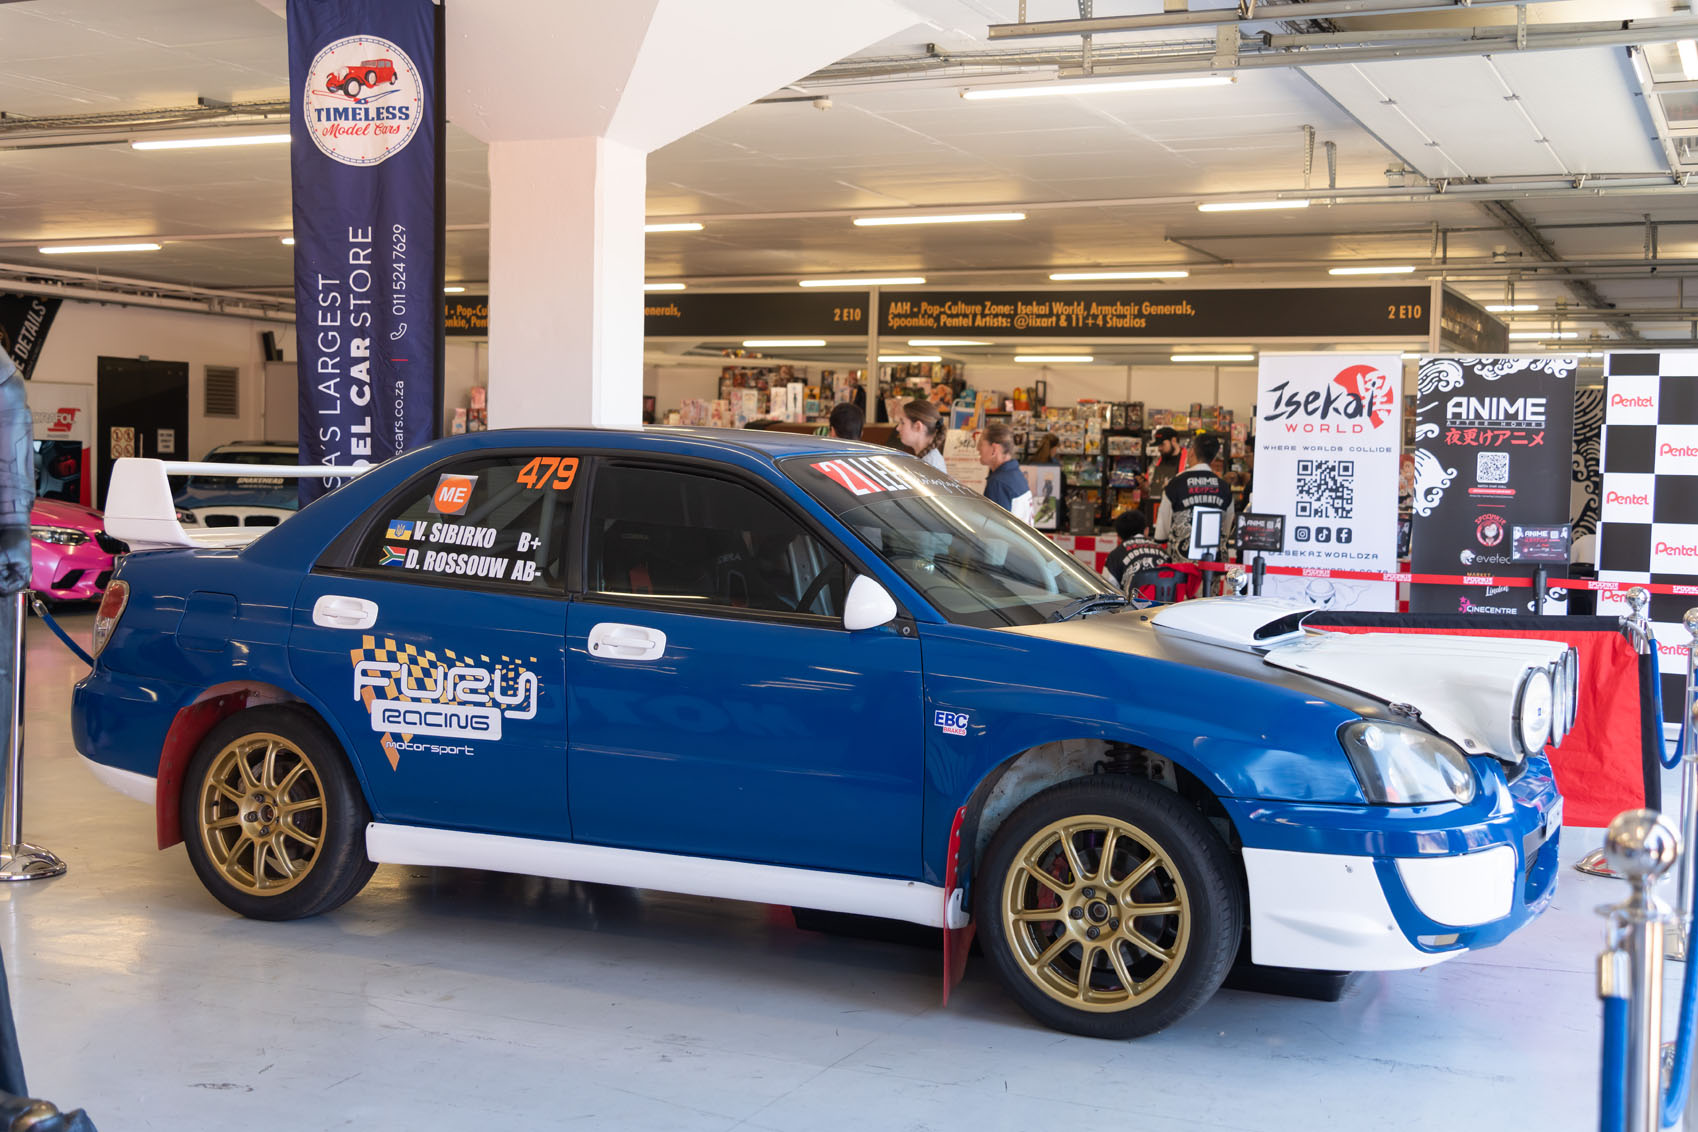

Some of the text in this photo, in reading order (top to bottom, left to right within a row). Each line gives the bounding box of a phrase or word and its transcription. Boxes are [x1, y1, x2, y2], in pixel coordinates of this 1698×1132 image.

[314, 106, 410, 122] TIMELESS
[322, 122, 401, 138] Model Cars
[392, 224, 406, 260] 7629
[349, 226, 372, 326] STORE
[392, 262, 406, 290] 524
[392, 294, 406, 316] 011
[456, 304, 488, 318] Pop-Cu
[889, 302, 911, 314] AAH
[921, 301, 982, 317] Pop-Culture
[984, 302, 1014, 314] Zone:
[1018, 301, 1050, 315] Isekai
[1052, 301, 1087, 317] World,
[1090, 301, 1140, 315] Armchair
[1142, 300, 1196, 316] Generals,
[1388, 305, 1422, 319] 2 E10
[834, 308, 862, 321] 2 E10
[888, 314, 1146, 330] Spoonkie, Pentel Artists: @iixart & 11+4 Studios
[14, 300, 46, 360] DETAILS
[318, 274, 341, 414] LARGEST
[350, 338, 371, 406] CAR
[1264, 380, 1376, 422] Isekai
[1446, 396, 1546, 420] ANIME
[1611, 393, 1654, 408] Pentel
[1285, 424, 1364, 434] WORLD
[1444, 428, 1545, 447] 夜更けアニメ
[516, 456, 580, 490] 479
[1187, 477, 1219, 486] ANIME
[438, 486, 468, 503] ME
[1606, 490, 1649, 505] Pentel
[413, 520, 542, 552] V. SIBIRKO B+
[404, 548, 542, 582] D. ROSSOUW AB-
[1466, 605, 1518, 615] CINECENTRE
[354, 660, 538, 720] FURY
[382, 708, 490, 731] RACING
[935, 711, 968, 728] EBC
[944, 726, 966, 736] BRAKES
[385, 741, 474, 756] motorsport
